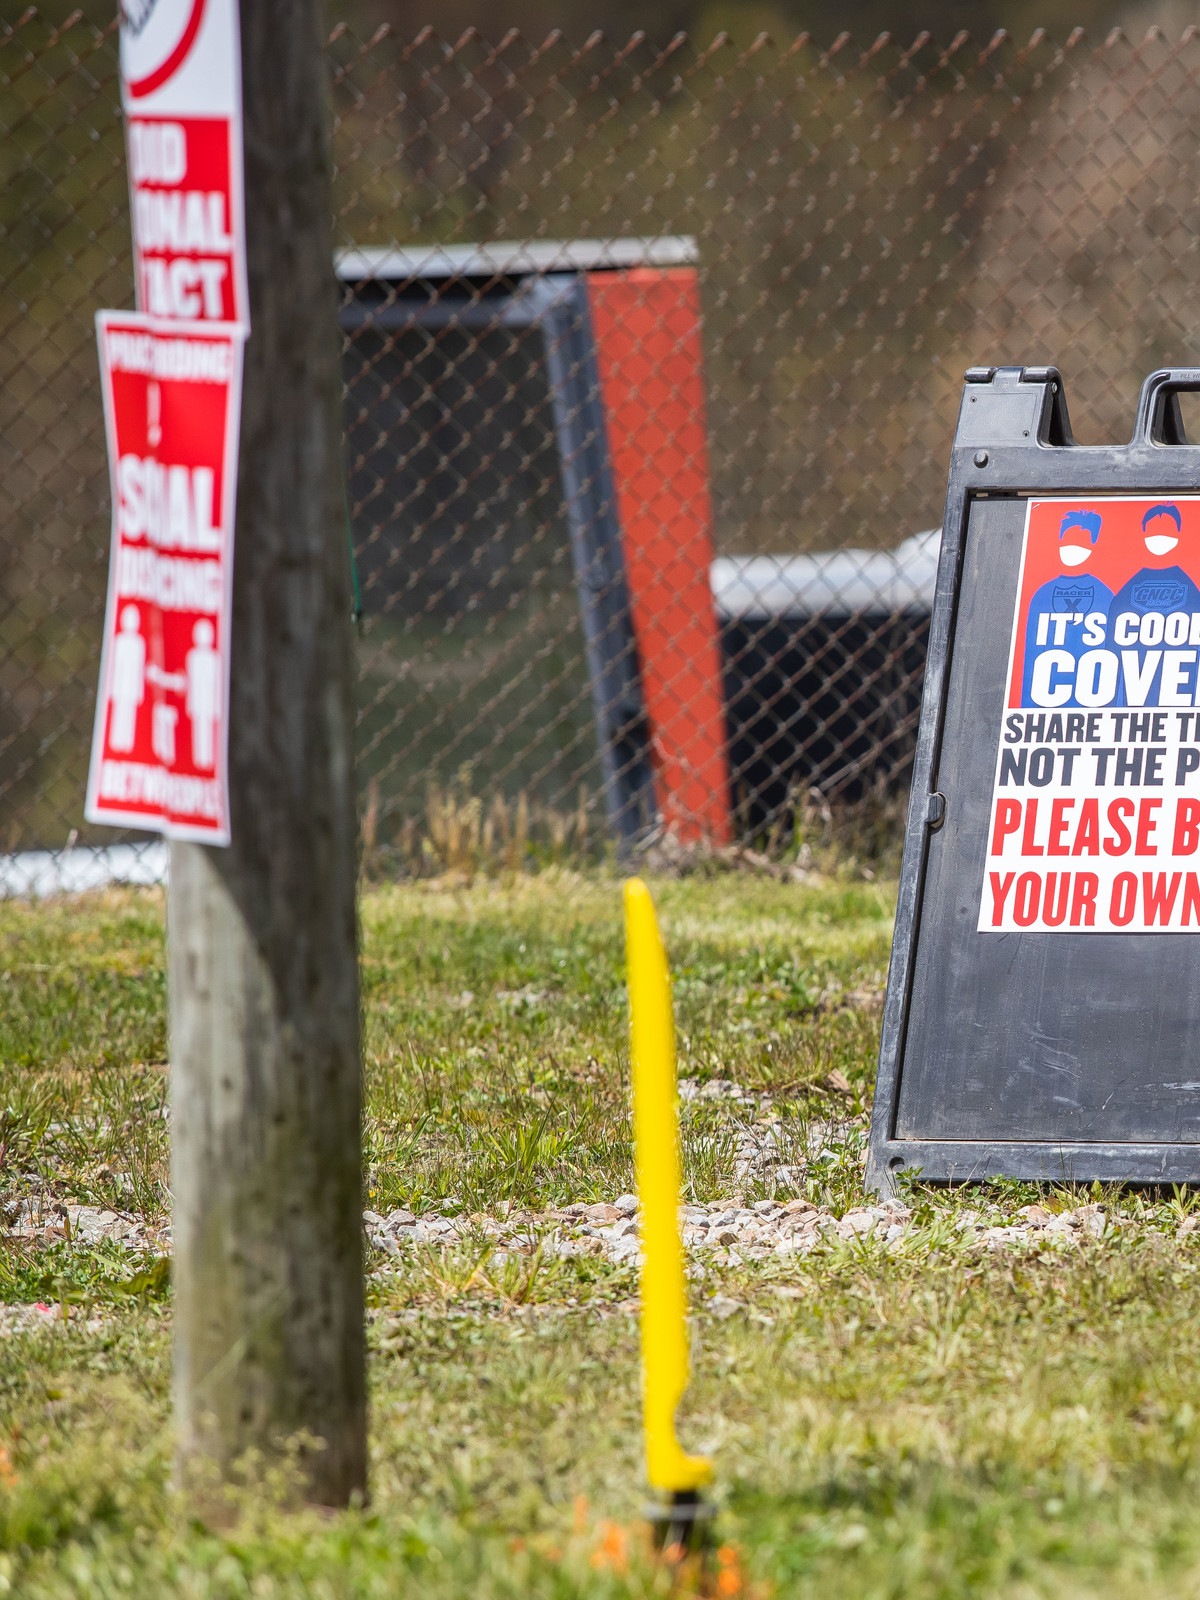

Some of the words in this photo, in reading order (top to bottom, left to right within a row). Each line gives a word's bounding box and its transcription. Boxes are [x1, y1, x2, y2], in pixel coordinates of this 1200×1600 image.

[1136, 588, 1186, 600] GNCC
[1036, 612, 1107, 646] IT'S
[1004, 713, 1102, 743] SHARE
[1107, 712, 1168, 743] THE
[998, 747, 1082, 787] NOT
[1091, 747, 1166, 786] THE
[991, 797, 1163, 857] PLEASE
[989, 871, 1099, 927] YOUR
